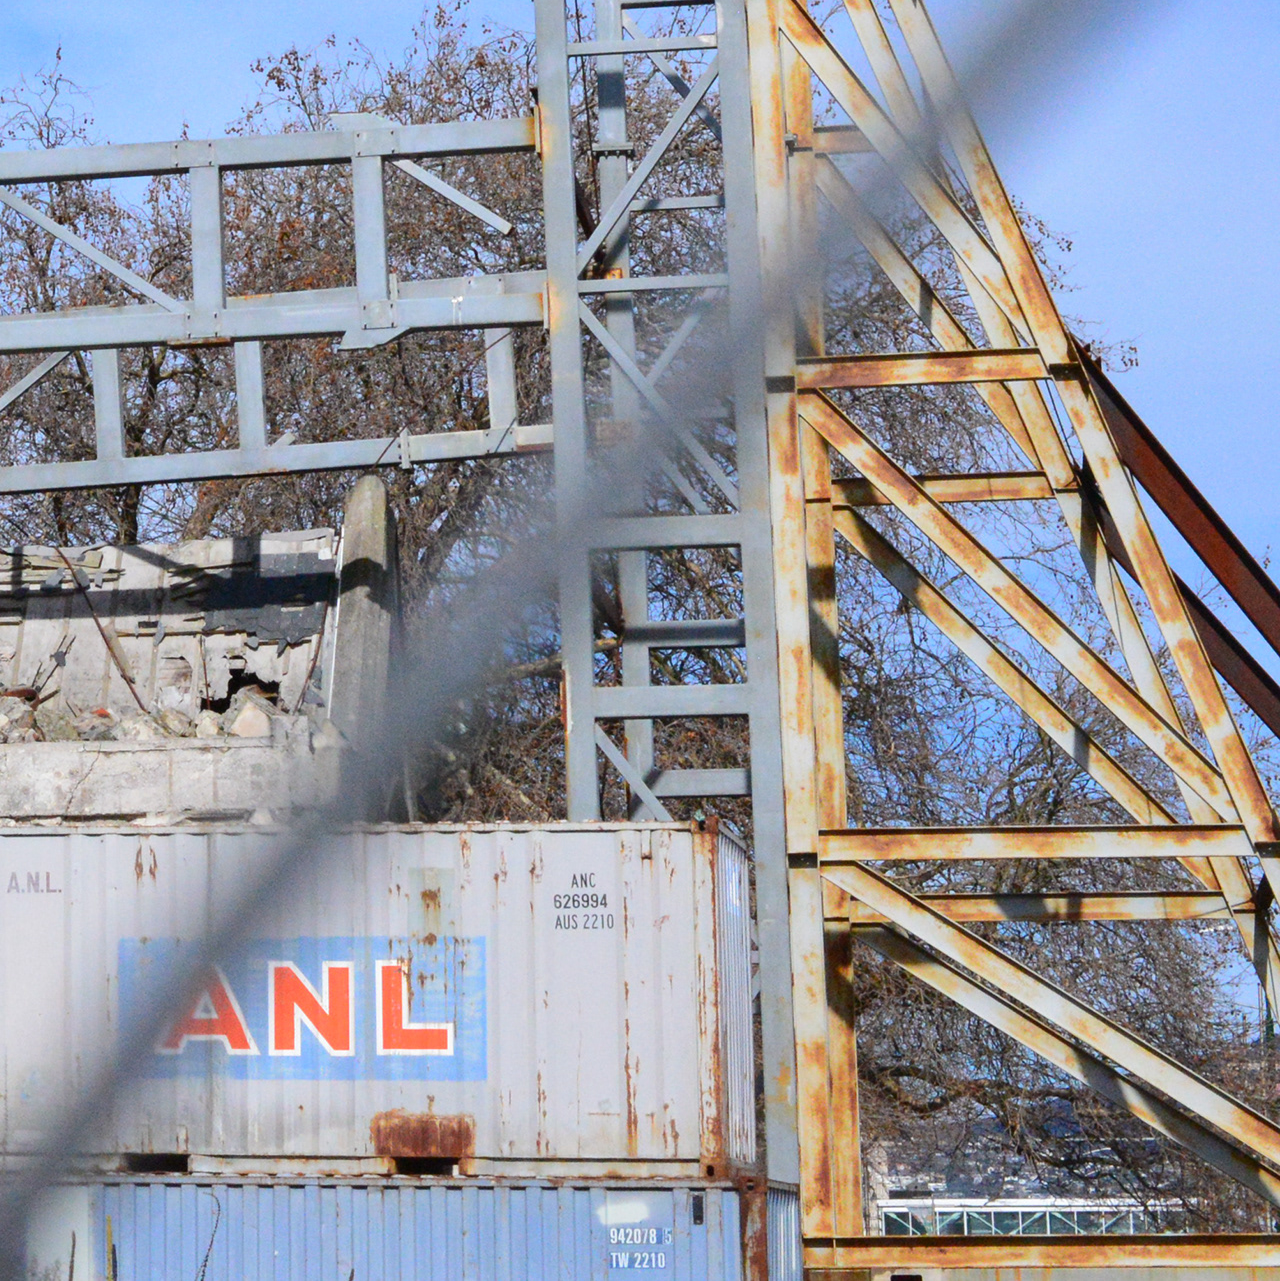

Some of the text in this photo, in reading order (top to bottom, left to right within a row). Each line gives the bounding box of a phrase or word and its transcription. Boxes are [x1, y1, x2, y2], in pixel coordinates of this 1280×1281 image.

[571, 872, 596, 888] ANC
[553, 893, 608, 909] 626994
[555, 913, 614, 929] AUS 2210
[154, 959, 454, 1056] ANL
[609, 1227, 657, 1244] 942078
[610, 1252, 666, 1268] TW 2210
